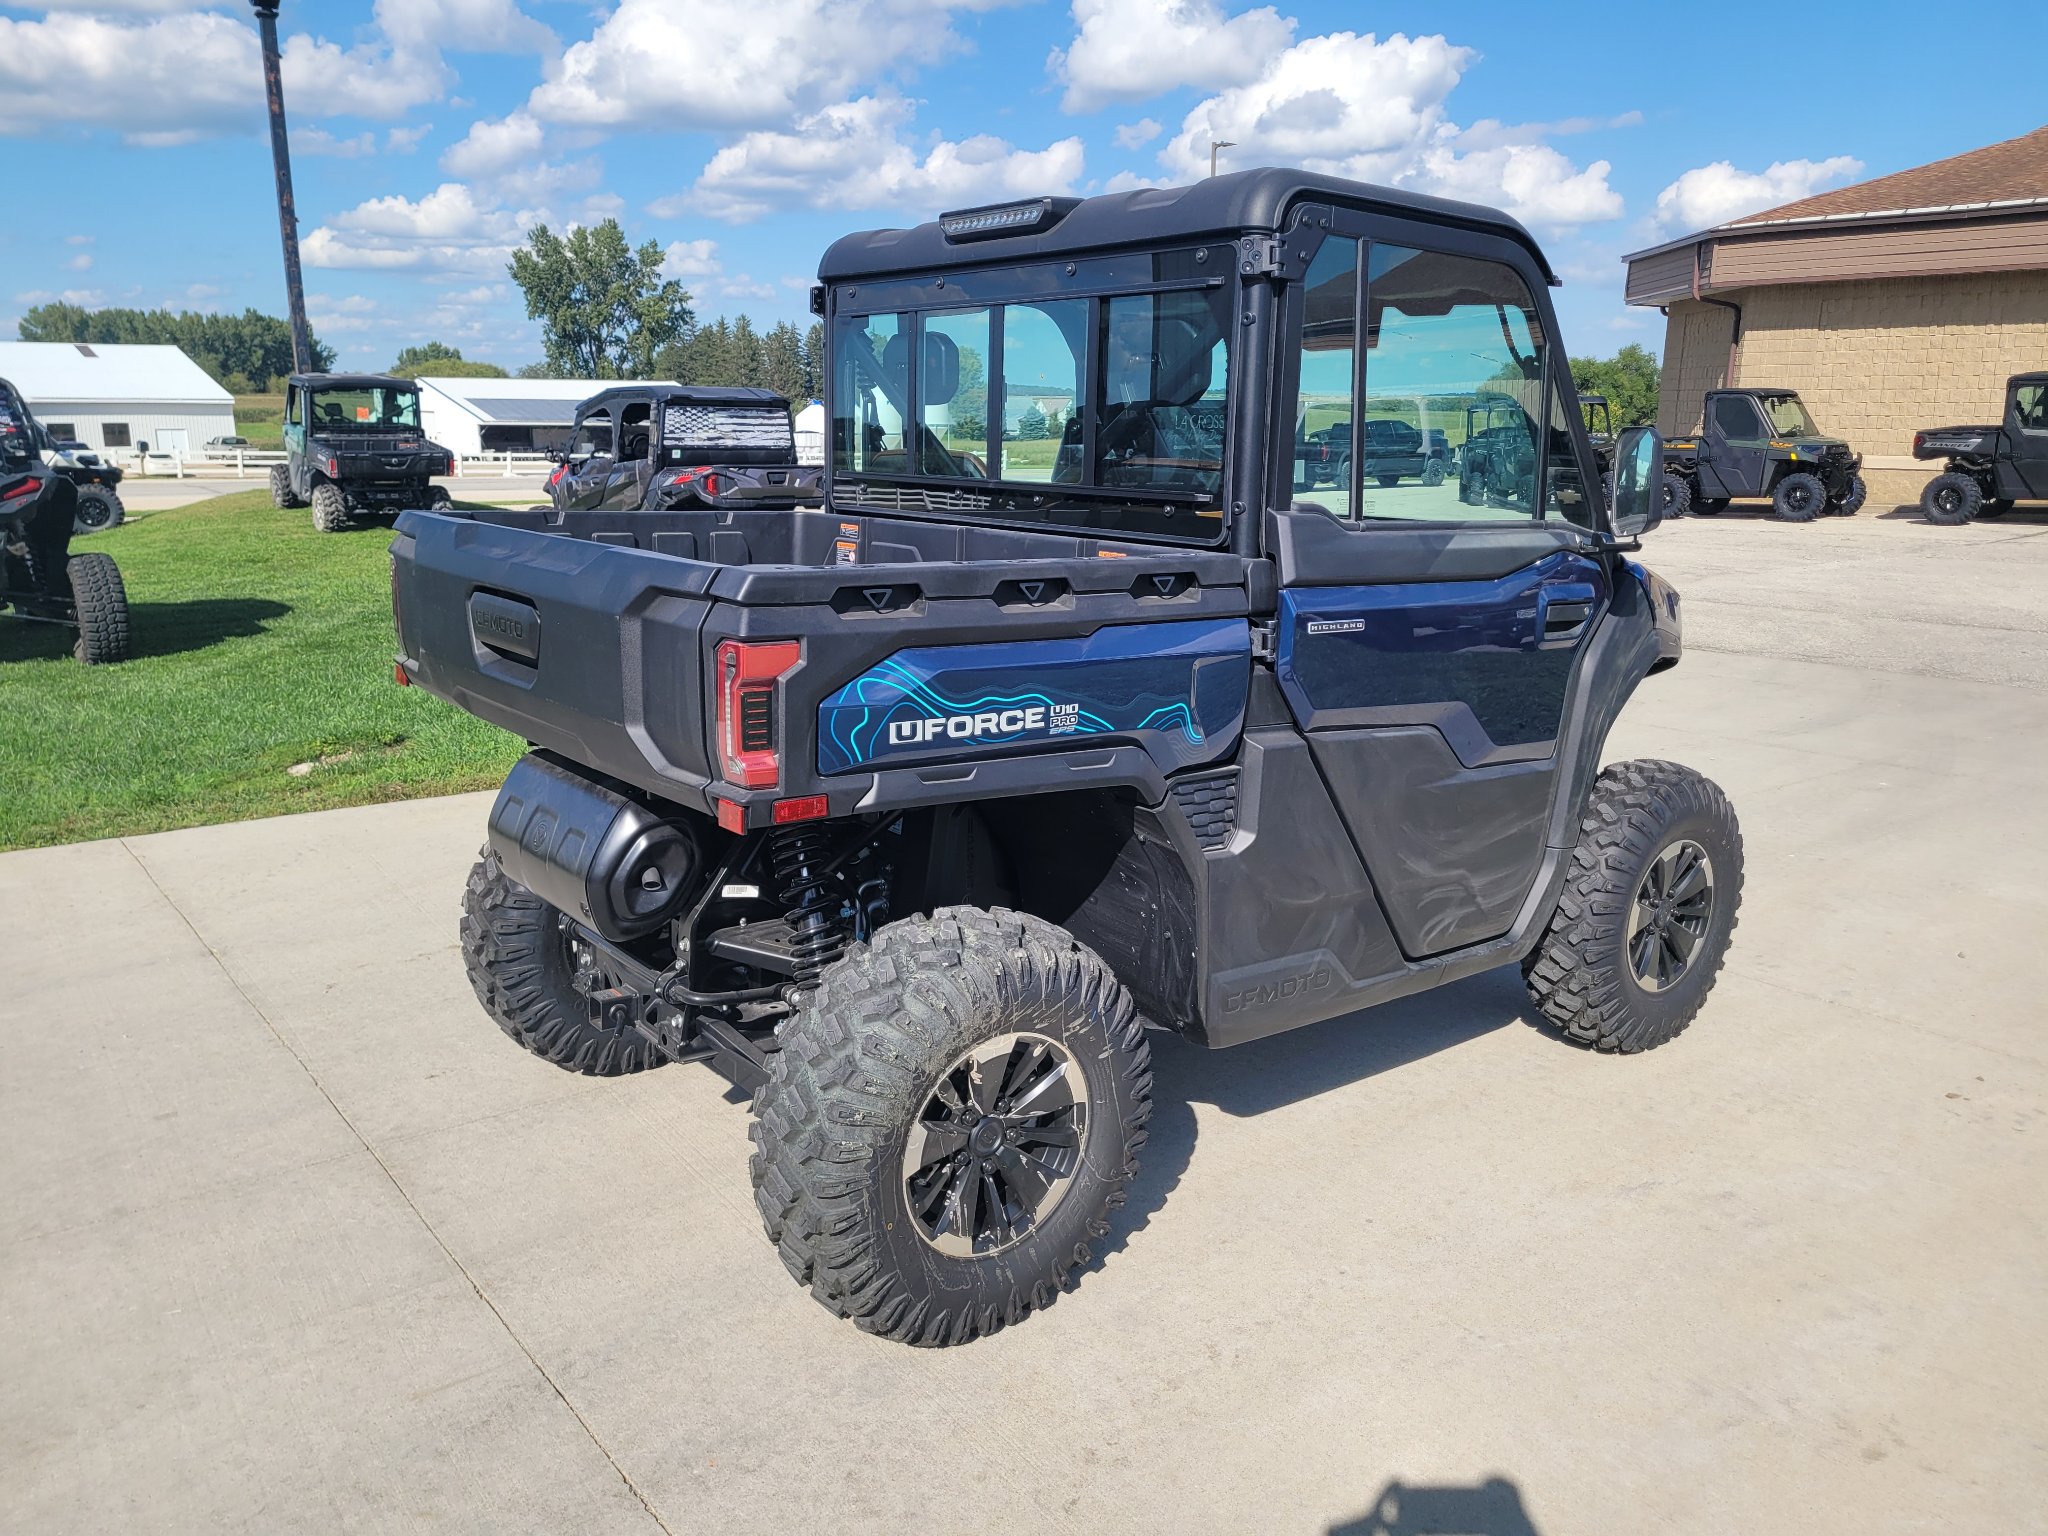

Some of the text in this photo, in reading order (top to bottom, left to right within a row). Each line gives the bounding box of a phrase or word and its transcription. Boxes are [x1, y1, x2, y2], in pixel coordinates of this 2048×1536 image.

[1310, 621, 1364, 632] HIGHLAND
[1050, 715, 1079, 728] PRO
[1049, 725, 1076, 735] EPS
[1221, 968, 1332, 1015] CFMOTO
